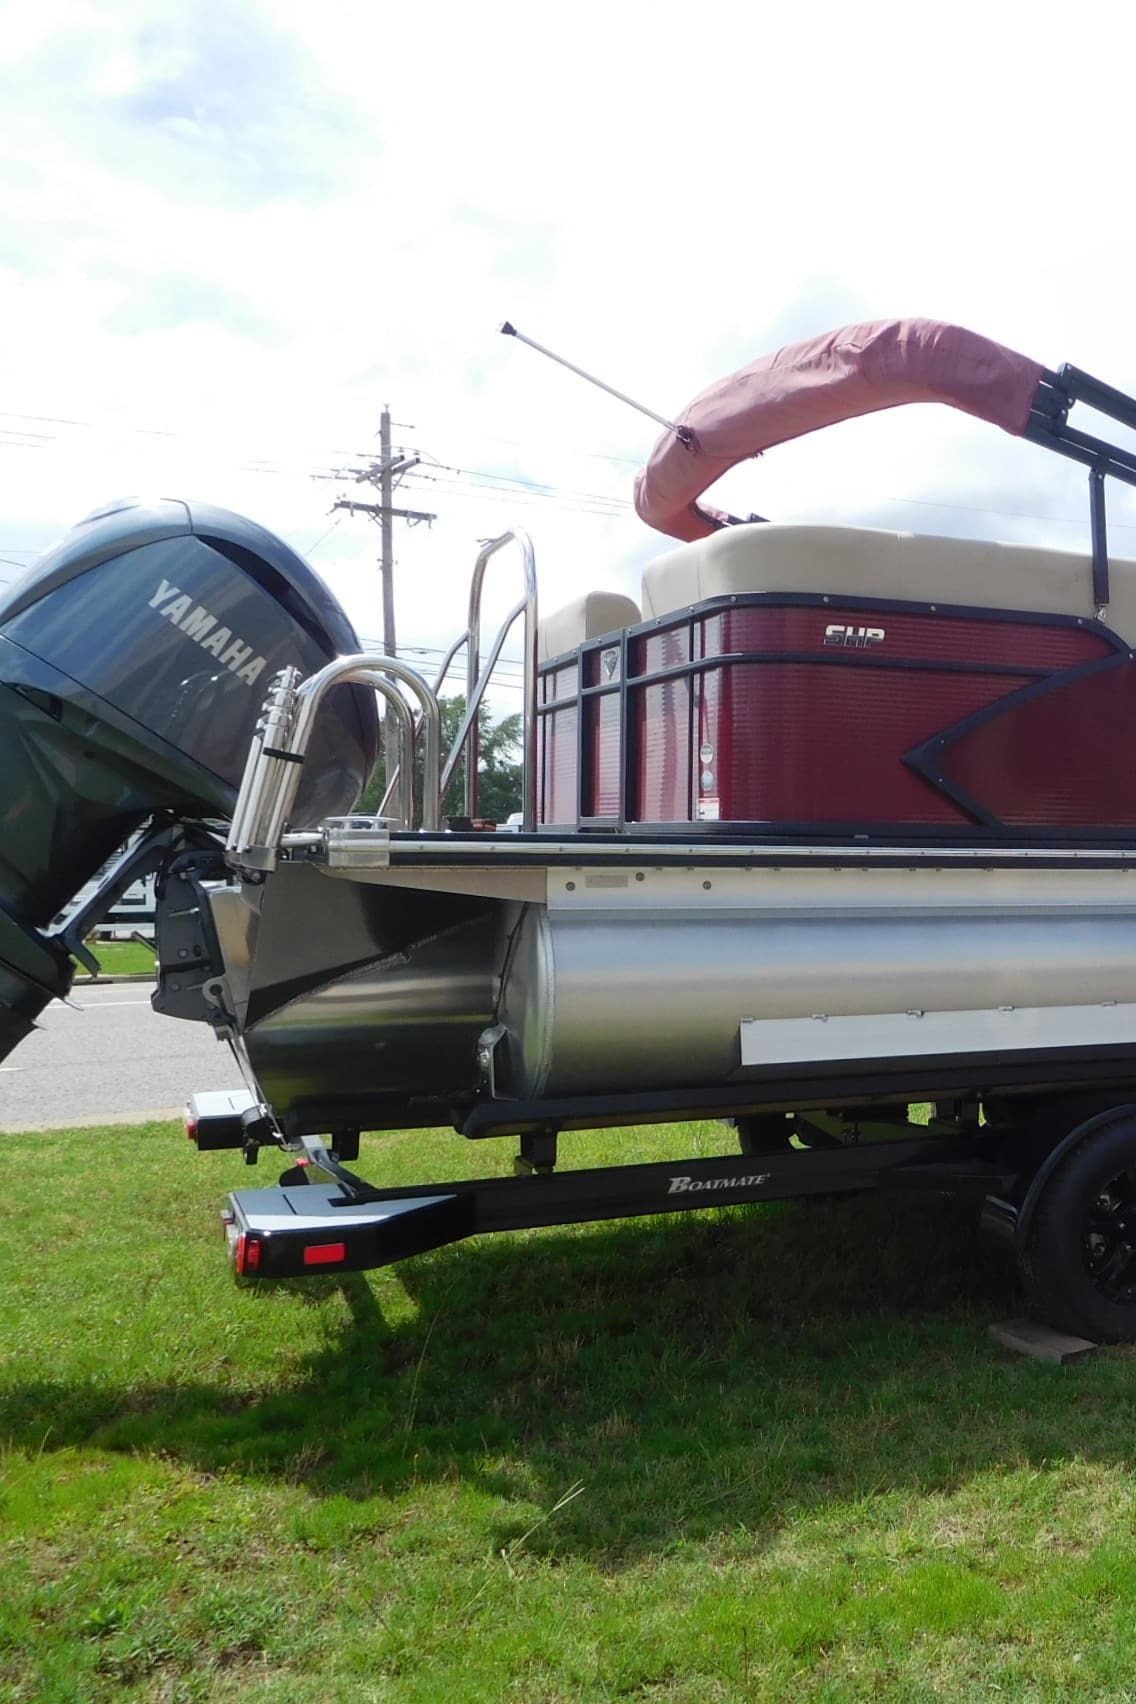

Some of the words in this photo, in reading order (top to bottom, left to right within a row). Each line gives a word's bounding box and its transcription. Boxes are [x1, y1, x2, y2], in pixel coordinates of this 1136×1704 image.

[148, 578, 267, 686] YAMAHA
[824, 625, 886, 648] SHP
[667, 1174, 766, 1194] BOATMATE
